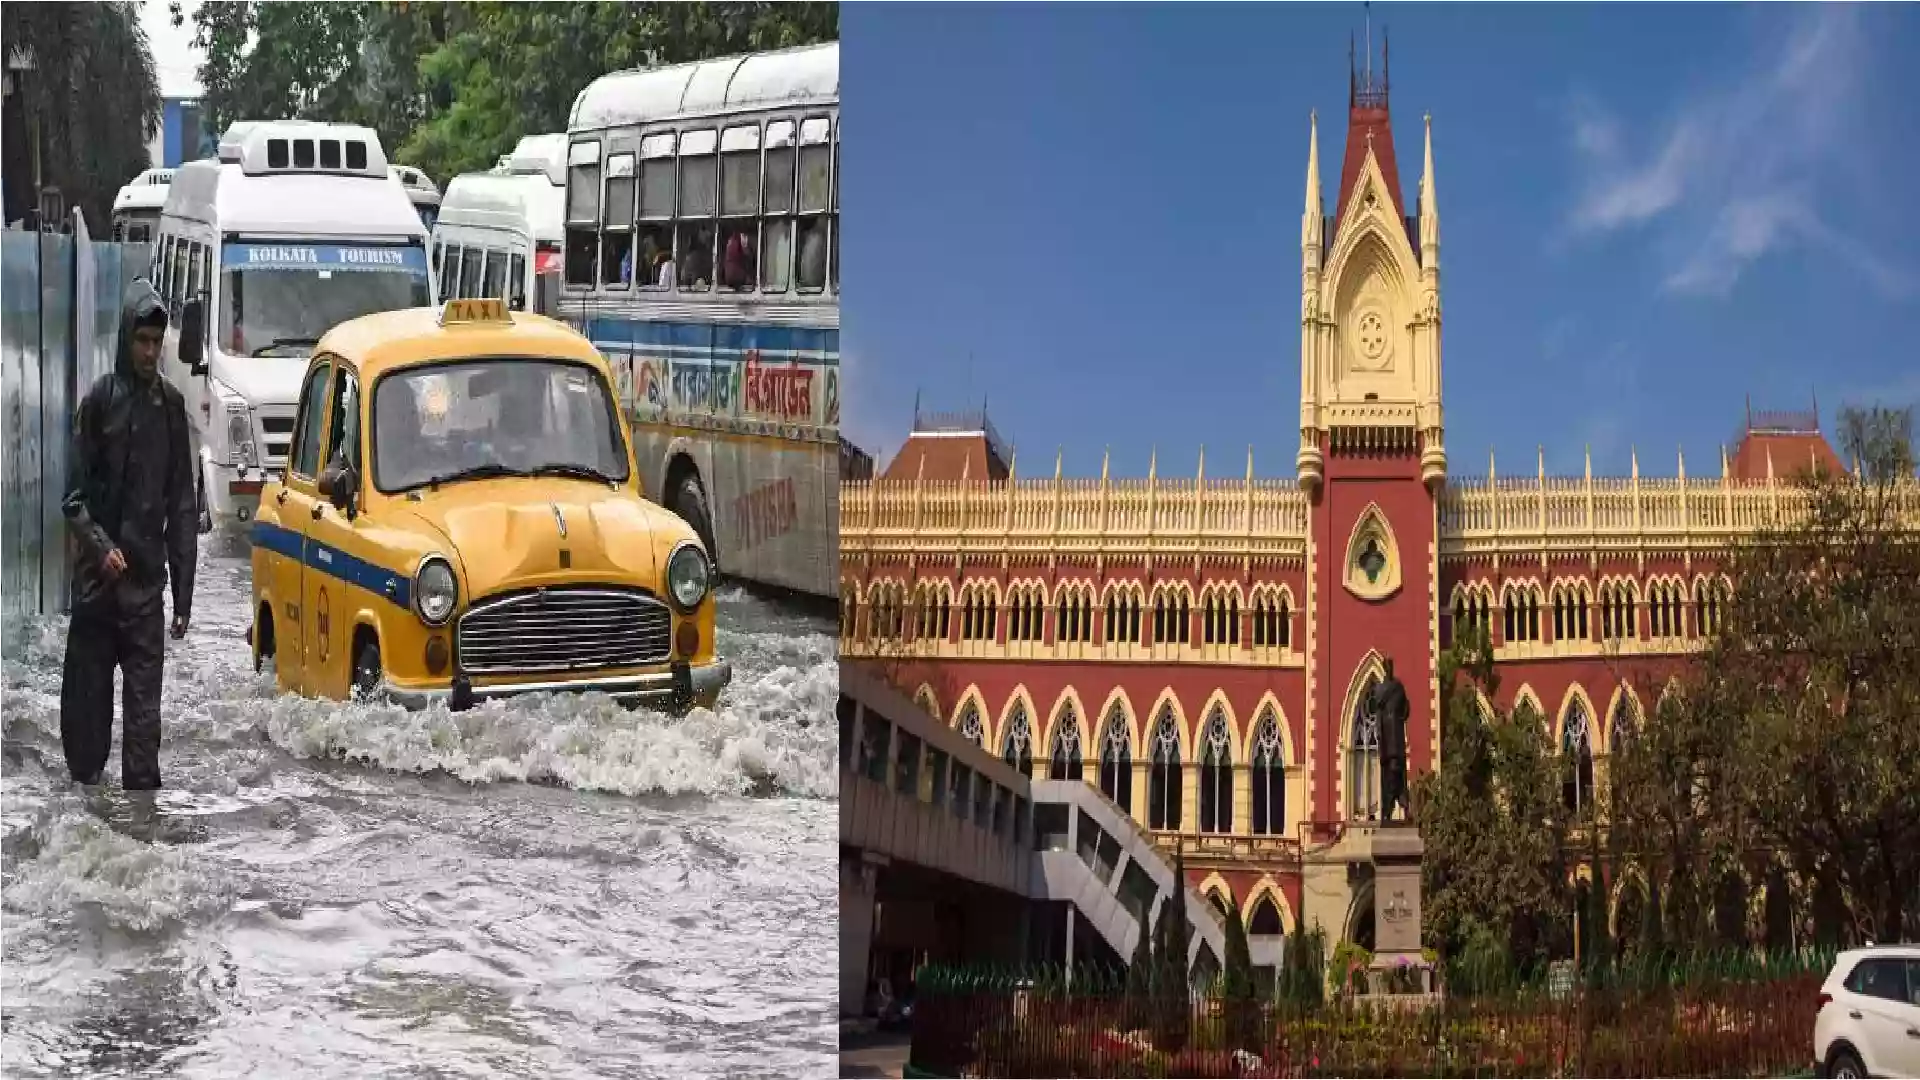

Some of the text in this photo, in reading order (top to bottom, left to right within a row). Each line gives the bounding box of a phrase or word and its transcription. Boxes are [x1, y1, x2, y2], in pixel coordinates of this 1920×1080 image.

[249, 247, 403, 264] KOLKATA TOURISM
[451, 301, 501, 320] TAXI
